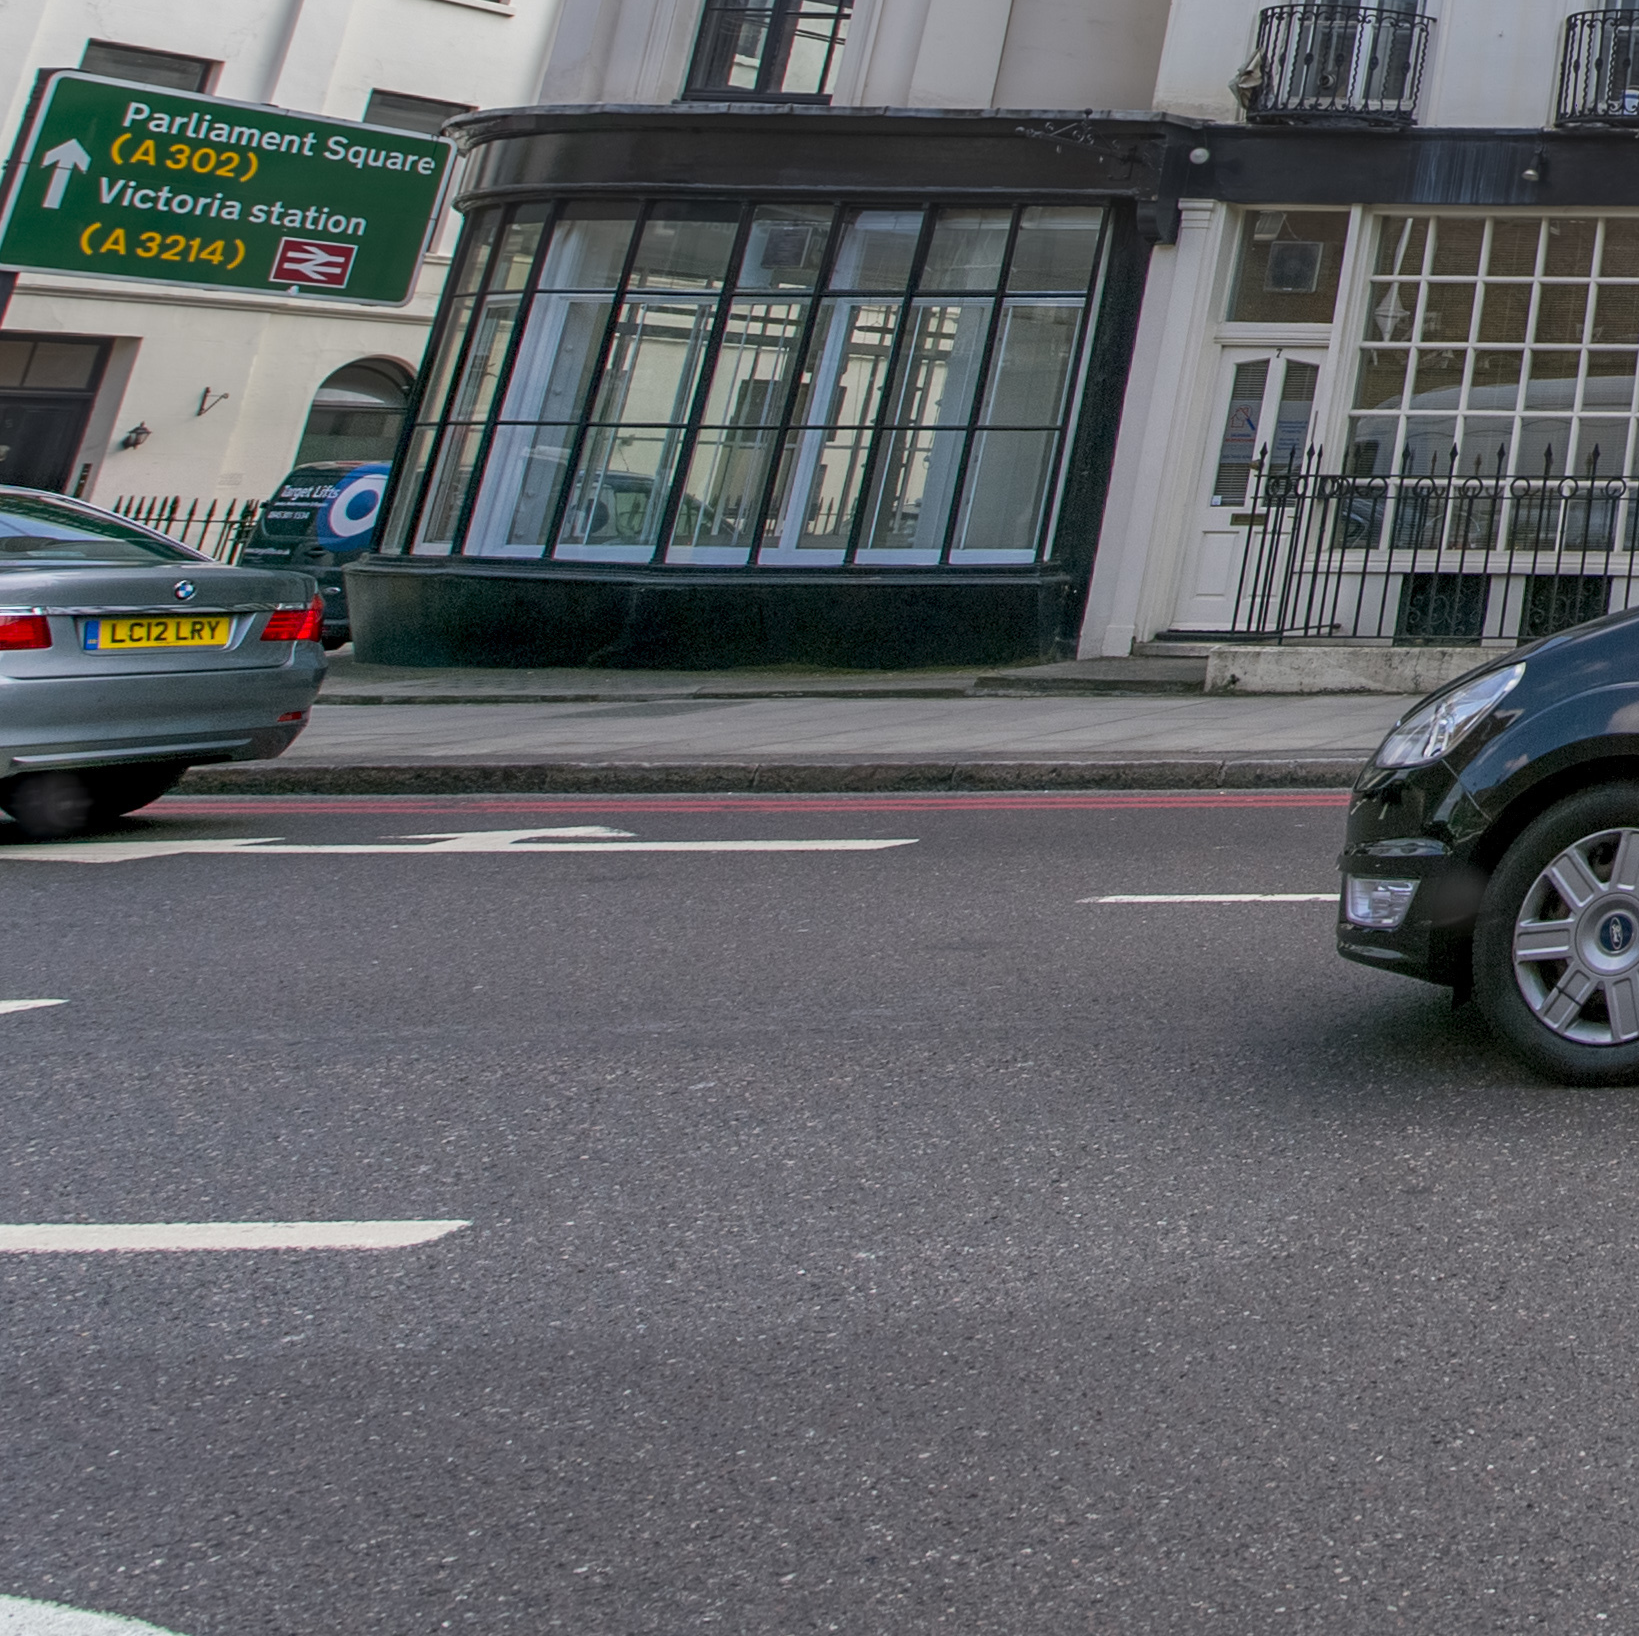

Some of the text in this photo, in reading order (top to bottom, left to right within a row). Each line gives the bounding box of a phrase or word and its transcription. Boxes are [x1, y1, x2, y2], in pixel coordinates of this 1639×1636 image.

[122, 101, 436, 175] Parliament Square
[166, 143, 259, 182] 302)
[98, 176, 367, 236] Victoria station
[135, 232, 246, 270] 3214)
[1276, 348, 1283, 358] 7
[281, 485, 341, 500] Target Lifts
[110, 620, 220, 643] LC12 LRY
